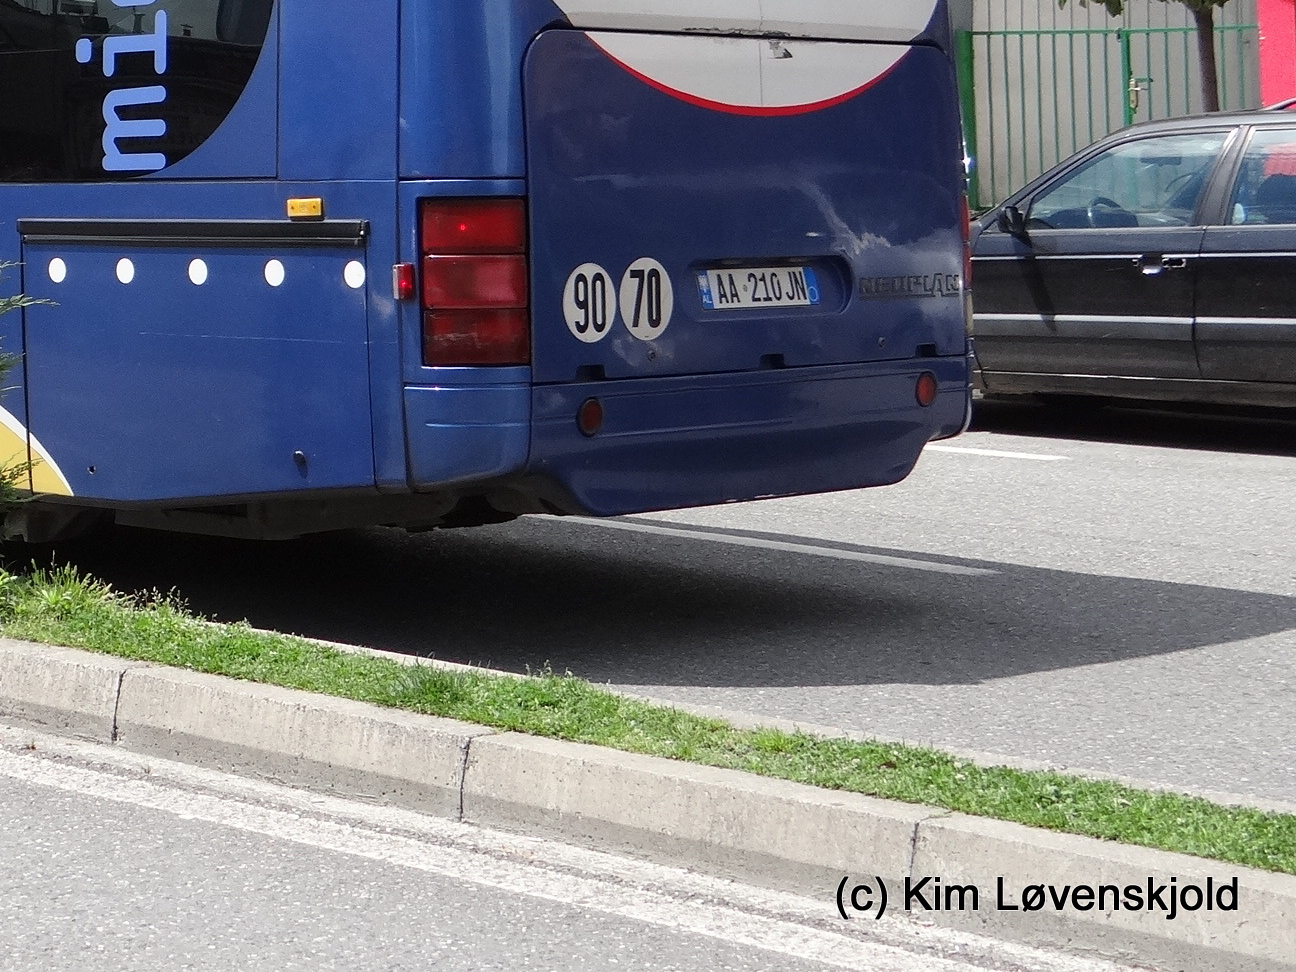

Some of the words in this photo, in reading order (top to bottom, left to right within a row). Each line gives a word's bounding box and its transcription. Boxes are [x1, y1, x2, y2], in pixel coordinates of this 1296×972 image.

[574, 273, 606, 333] 90
[629, 268, 661, 329] 70
[716, 273, 741, 304] AA
[747, 272, 782, 302] 210
[785, 271, 808, 301] JN
[859, 272, 960, 298] NEOPLAN
